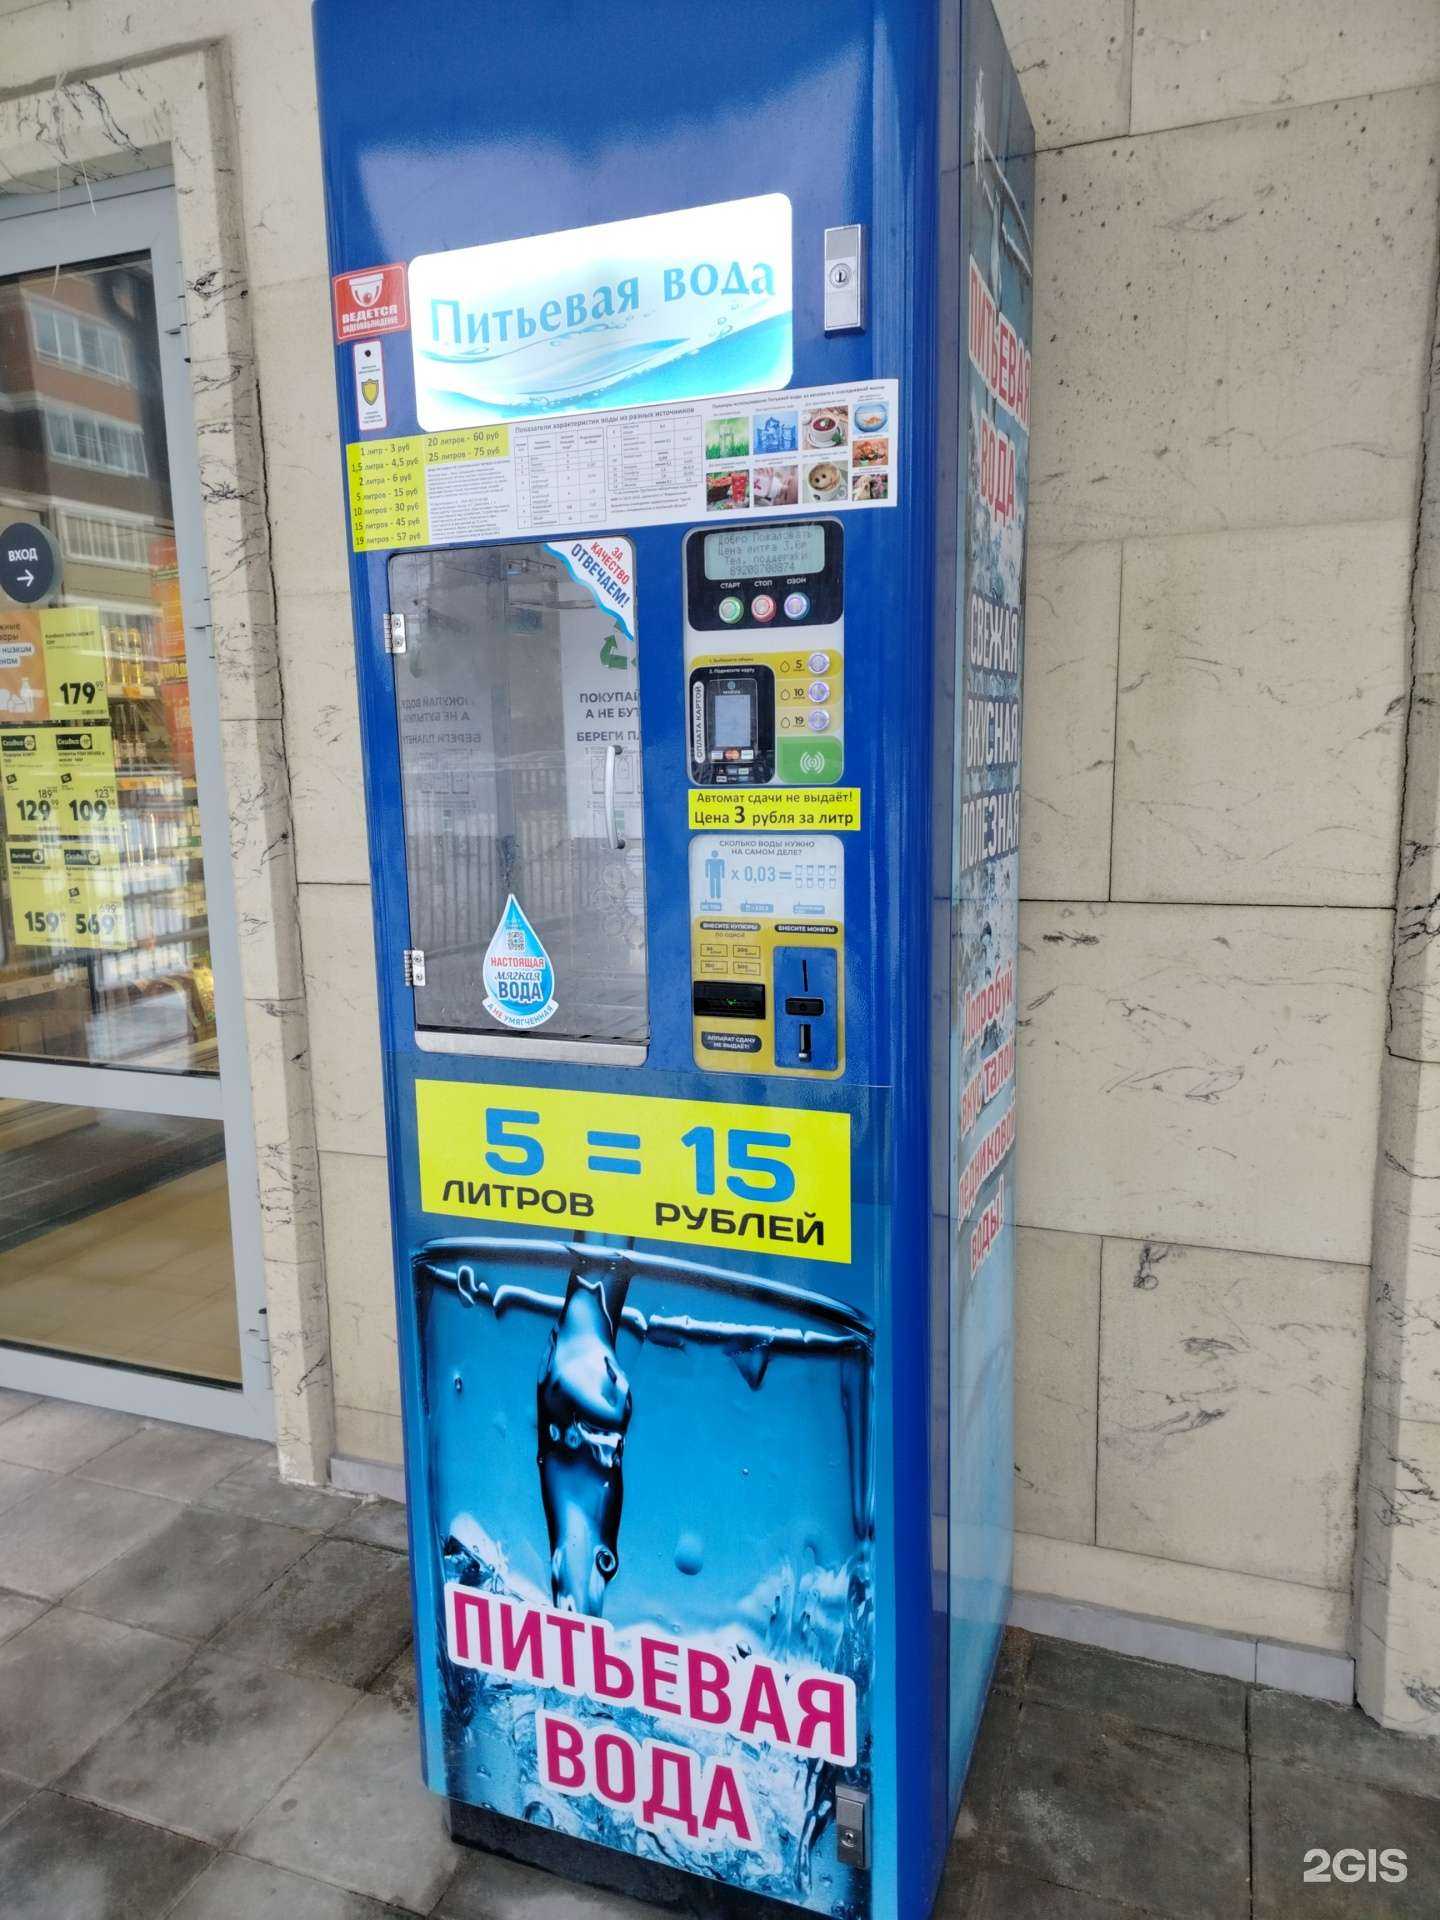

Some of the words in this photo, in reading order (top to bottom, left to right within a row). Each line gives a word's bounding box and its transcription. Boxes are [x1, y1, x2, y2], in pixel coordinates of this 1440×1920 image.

[431, 276, 640, 346] Питьевая
[664, 260, 776, 302] вода
[342, 304, 398, 325] ВЕДЕТСЯ
[970, 265, 1031, 429] ПИТЬЕВАЯ
[428, 438, 438, 446] 20
[473, 432, 484, 441] 60
[391, 458, 405, 468] 4,5
[428, 452, 439, 462] 25
[474, 446, 485, 456] 75
[981, 418, 1015, 527] ВОДА
[394, 488, 404, 497] 15
[354, 506, 362, 517] 10
[394, 502, 405, 512] 30
[354, 522, 364, 531] 15
[395, 517, 406, 526] 45
[355, 536, 364, 546] 19
[396, 532, 407, 541] 57
[8, 548, 38, 562] ВХОД
[590, 542, 630, 585] КАЧЕСТВО
[612, 547, 624, 560] ЗА
[571, 543, 630, 608] ОТВЕЧАЕМ!
[971, 594, 1018, 673] СВЕЖАЯ
[796, 660, 802, 668] 5
[60, 682, 96, 704] 179
[586, 709, 594, 718] А
[598, 708, 614, 718] НЕ
[794, 716, 804, 724] 19
[576, 731, 624, 742] БЕРЕГИ
[628, 730, 639, 740] П
[967, 698, 1018, 768] ВКУСНАЯ
[697, 793, 744, 803] Автомат
[748, 794, 782, 804] сдачи
[804, 792, 852, 804] выдаёт!
[17, 800, 51, 821] 129
[69, 800, 108, 821] 109
[695, 812, 730, 825] Цена
[734, 806, 746, 824] 3
[753, 812, 794, 826] рубля
[800, 814, 814, 824] за
[818, 814, 853, 826] литр
[961, 790, 1020, 871] ПОЛЕЗНАЯ
[744, 866, 776, 884] 0,03
[24, 911, 60, 932] 159
[76, 913, 115, 935] 569
[490, 956, 545, 968] НАСТОЯЩАЯ
[494, 970, 540, 981] мягкая
[498, 981, 542, 1002] ВОДА
[965, 958, 1013, 1046] Попробуй
[484, 1107, 545, 1177] 5
[586, 1130, 642, 1175] =
[680, 1126, 796, 1204] 15
[442, 1179, 595, 1217] ЛИТРОВ
[655, 1201, 825, 1246] РУБЛЕЙ
[453, 1591, 846, 1758] ПИТЬЕВАЯ
[544, 1717, 753, 1841] ВОДА
